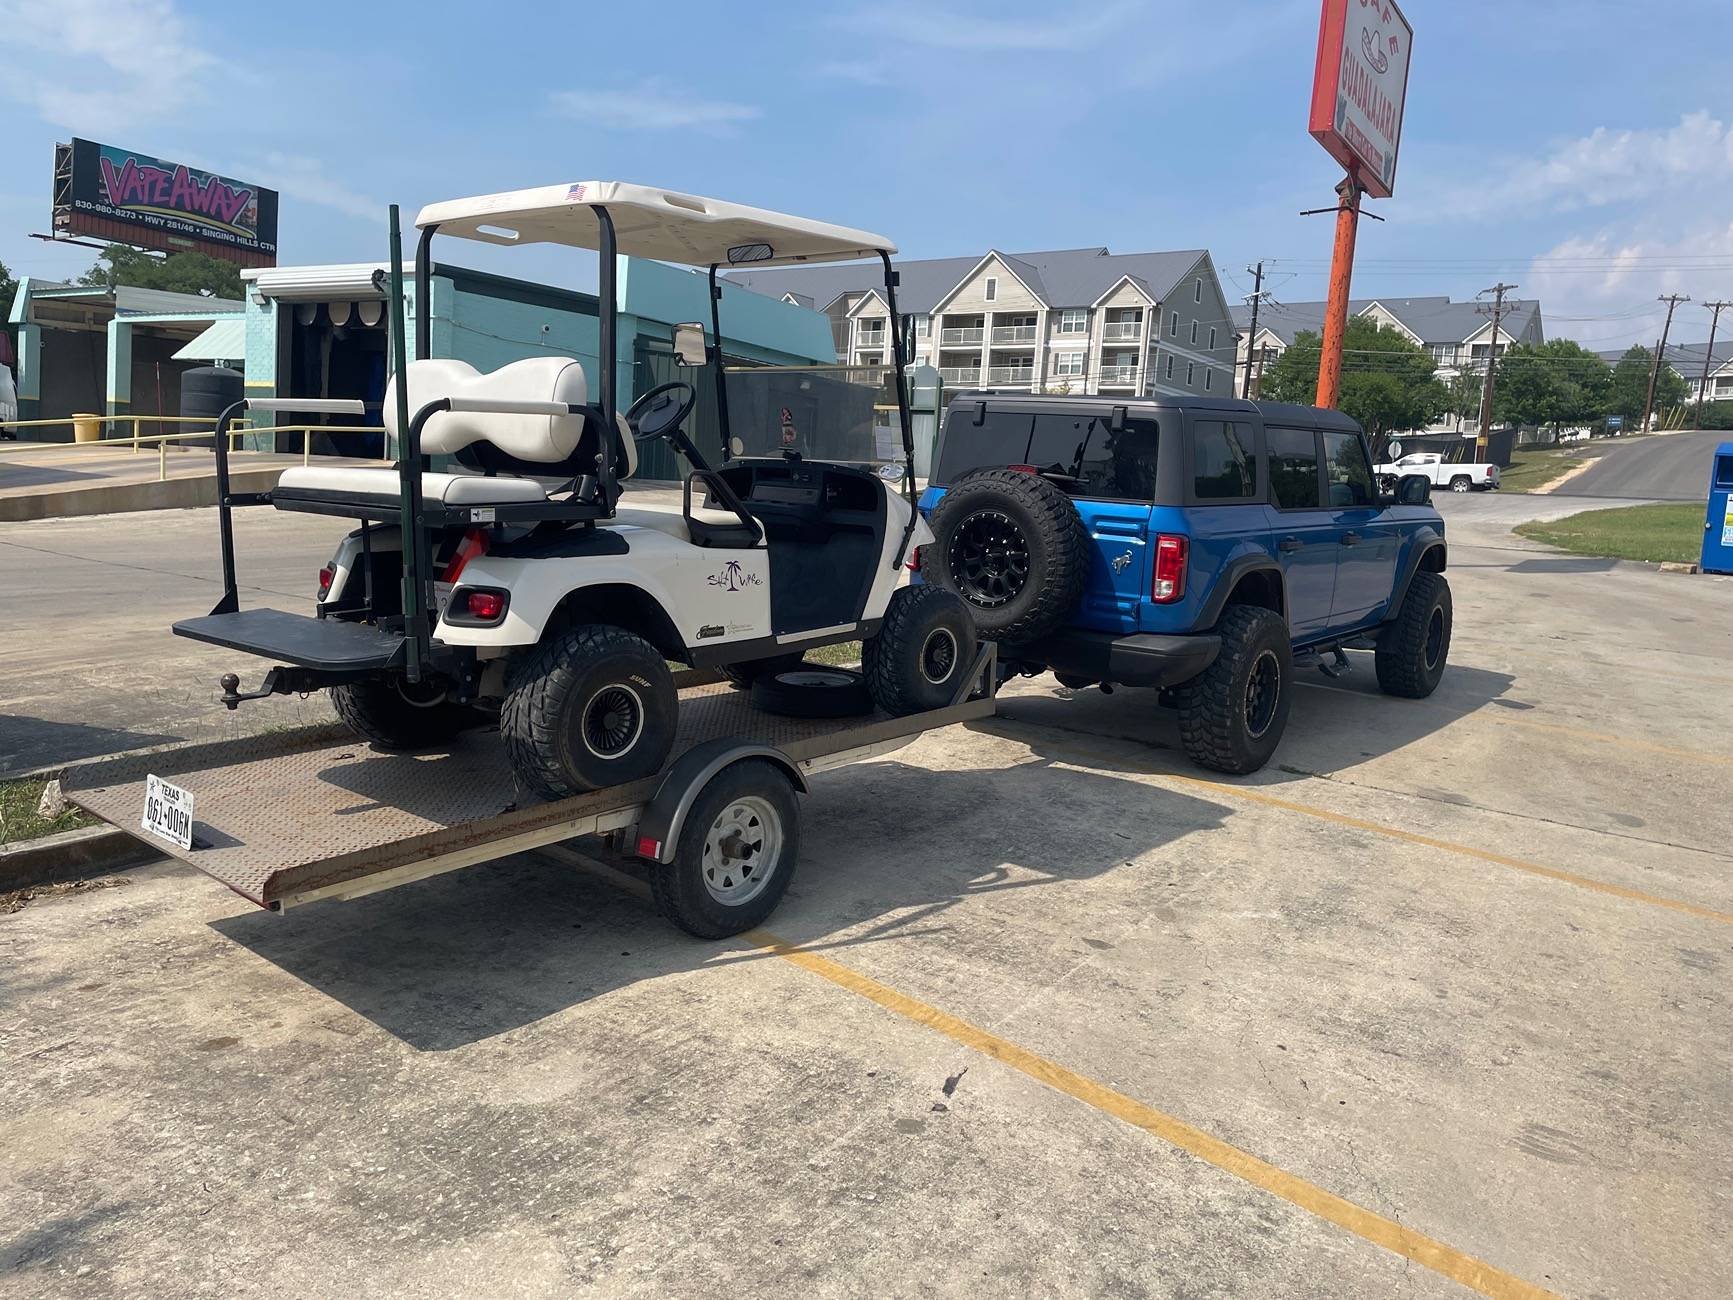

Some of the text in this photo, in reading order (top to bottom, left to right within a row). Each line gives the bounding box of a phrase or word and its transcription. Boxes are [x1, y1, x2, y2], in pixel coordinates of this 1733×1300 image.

[1341, 47, 1396, 146] GUADALAJARA
[75, 200, 136, 219] 830-980-8273
[145, 215, 165, 226] HWY
[167, 220, 194, 232] 281/46
[202, 228, 236, 242] SINGING
[237, 236, 258, 247] HILLS
[260, 242, 276, 251] CTR
[161, 784, 180, 801] TEXAS
